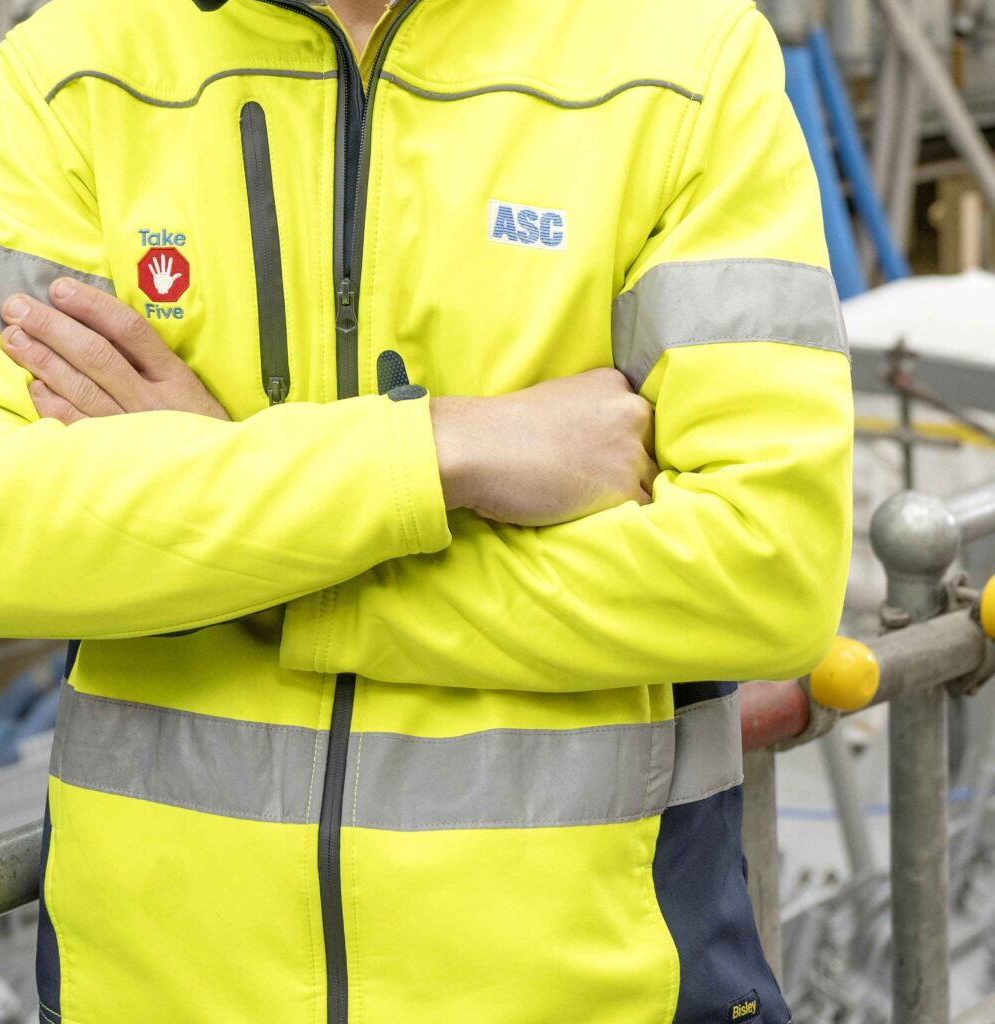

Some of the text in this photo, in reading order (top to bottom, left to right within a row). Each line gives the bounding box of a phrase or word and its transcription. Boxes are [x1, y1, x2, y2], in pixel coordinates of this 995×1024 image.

[492, 205, 563, 246] ASC
[138, 229, 186, 246] Take
[145, 303, 184, 319] Five
[732, 1000, 757, 1020] Bisley
